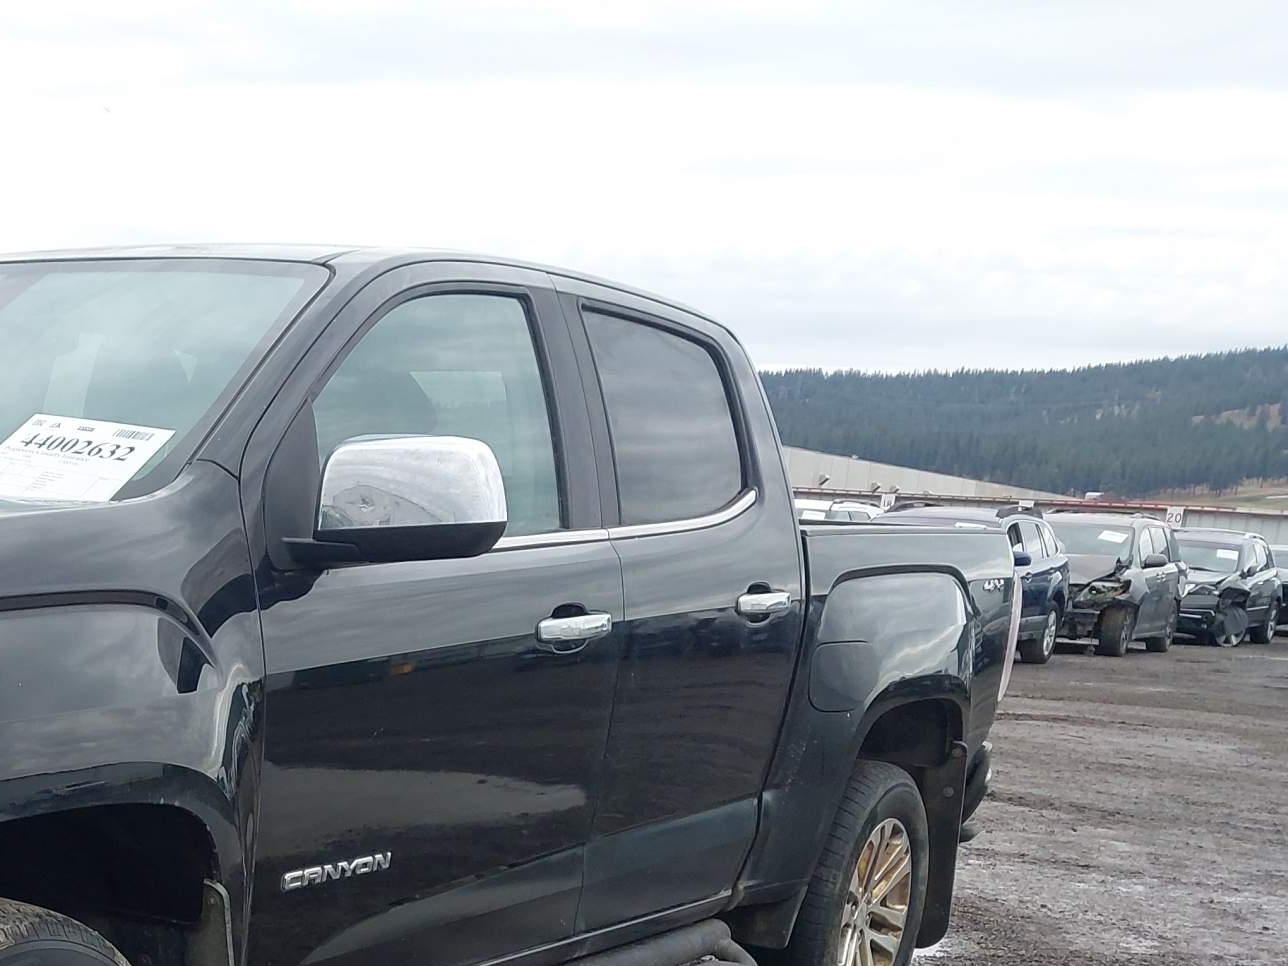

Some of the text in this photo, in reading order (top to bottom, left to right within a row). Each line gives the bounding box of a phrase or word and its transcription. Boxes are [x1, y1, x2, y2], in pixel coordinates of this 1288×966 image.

[20, 432, 136, 461] 44002632
[1167, 512, 1182, 523] 20
[281, 851, 392, 891] CANYON
